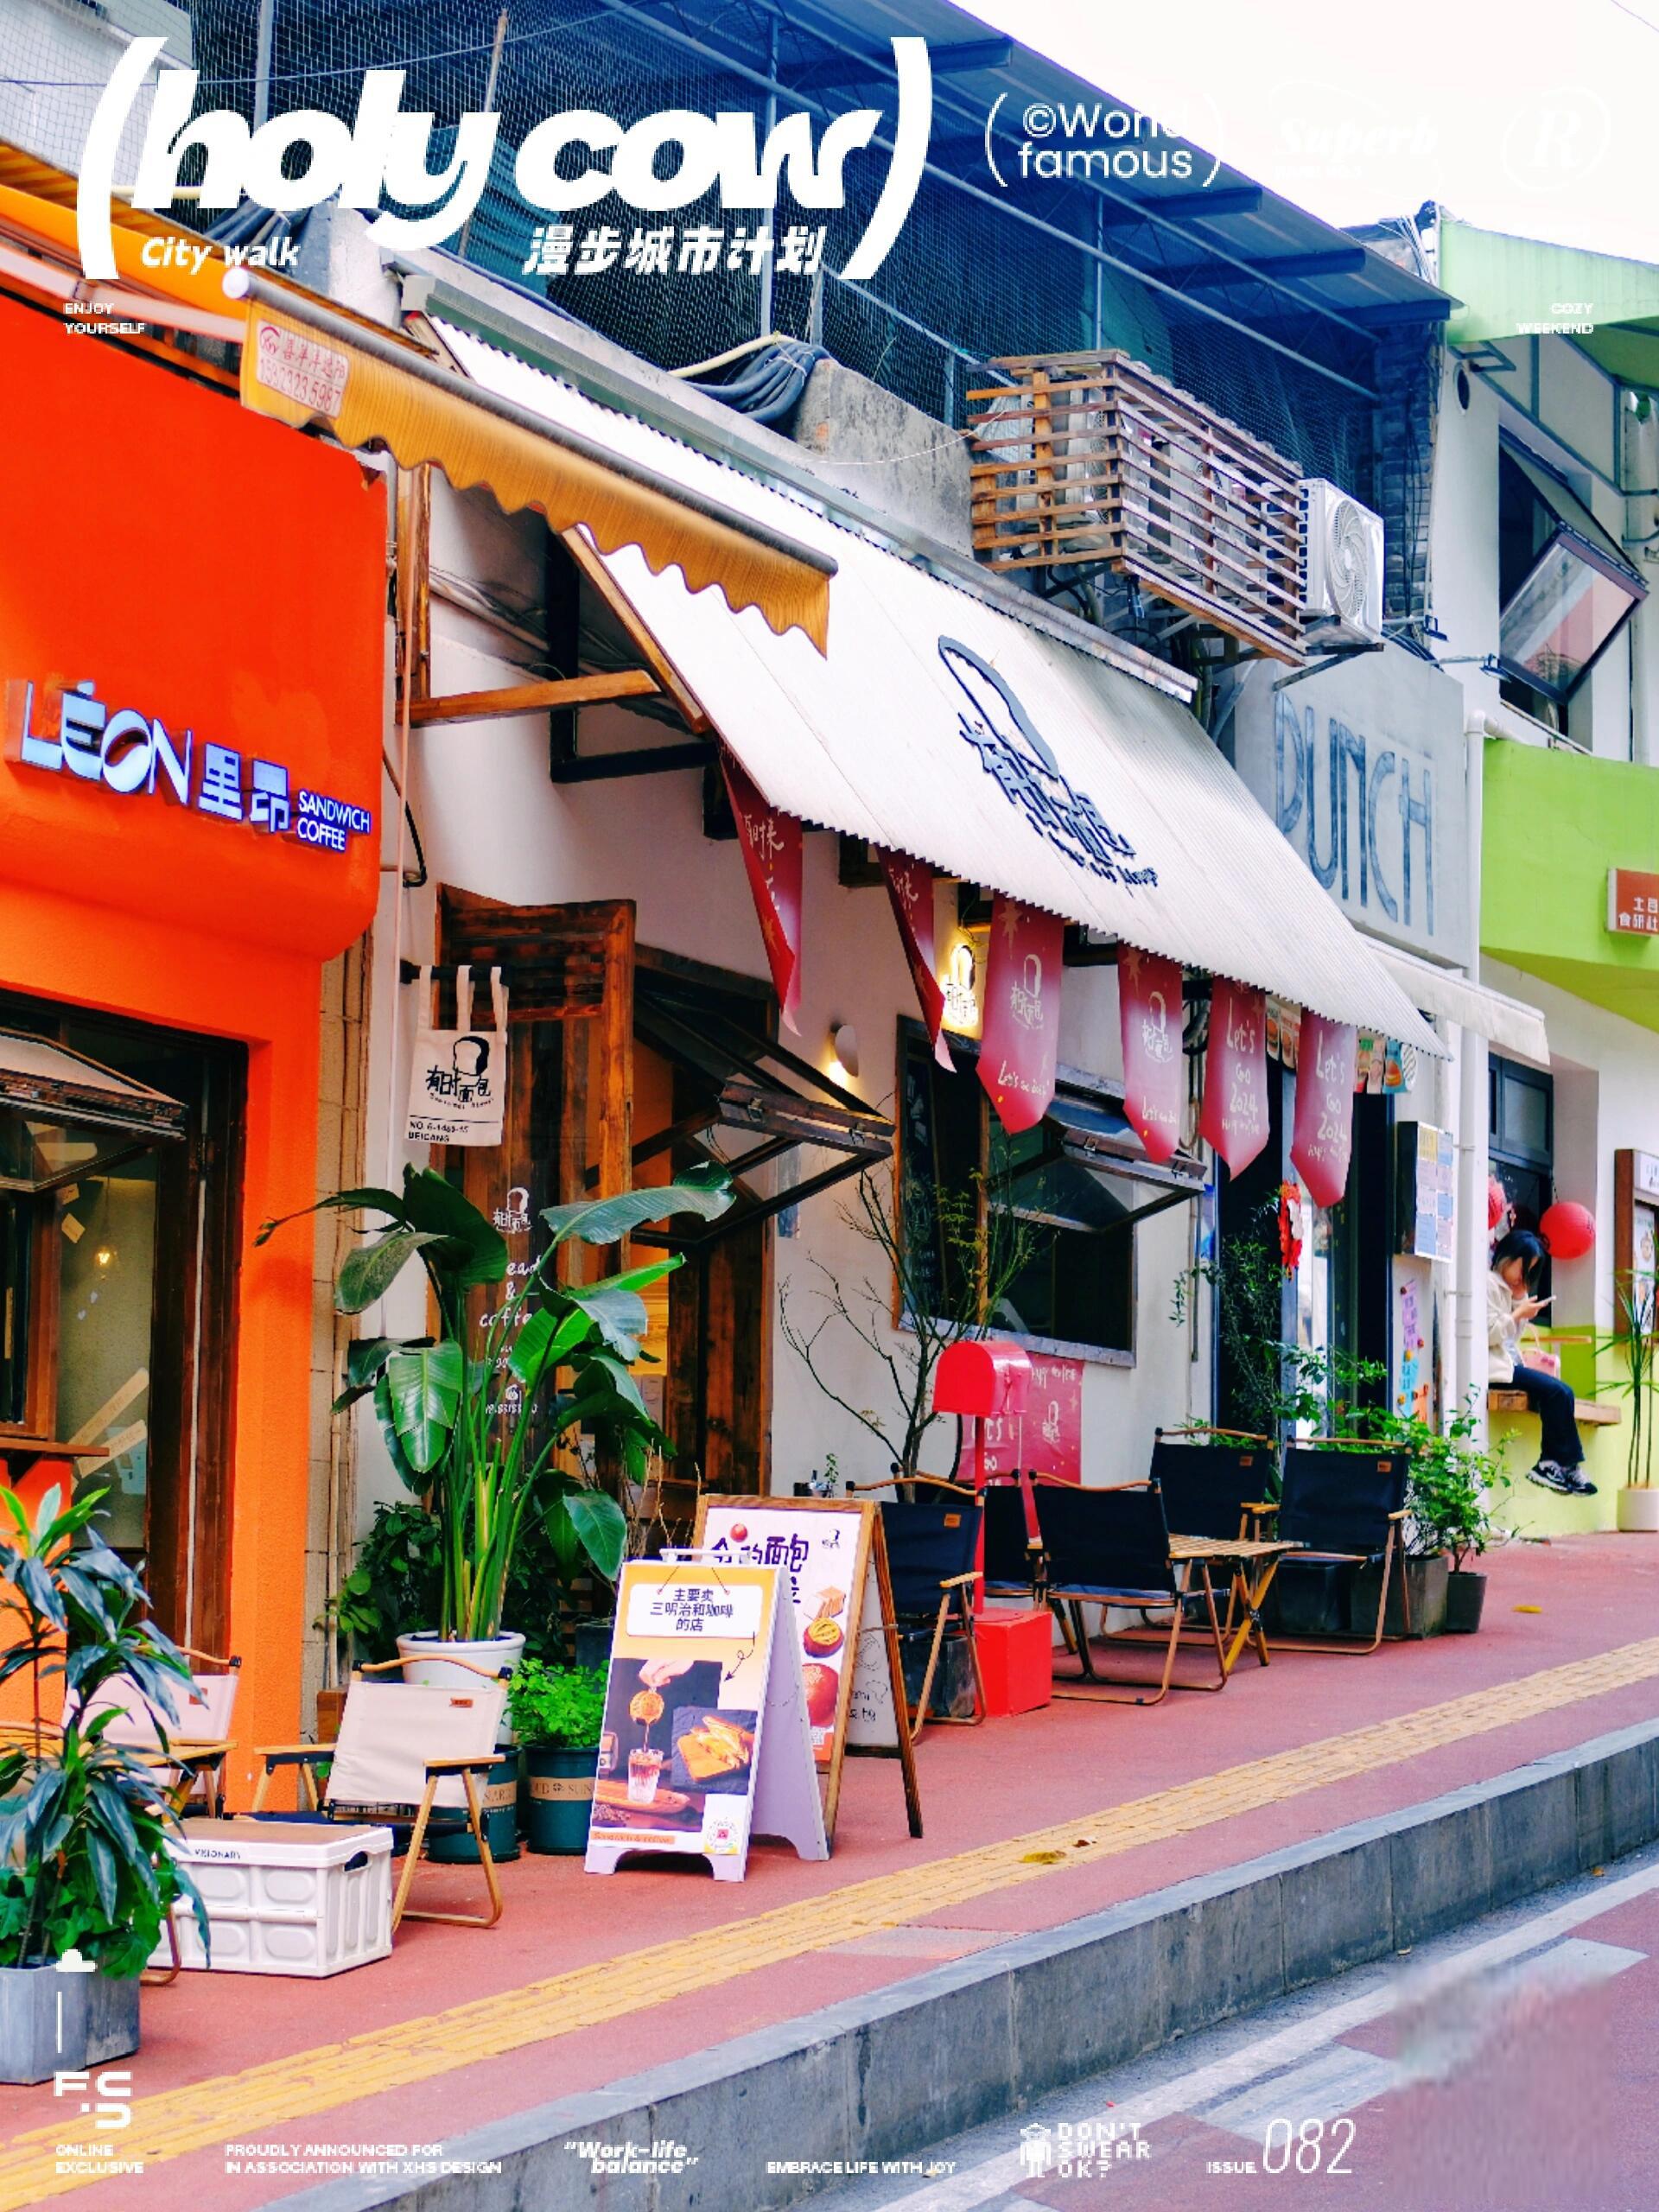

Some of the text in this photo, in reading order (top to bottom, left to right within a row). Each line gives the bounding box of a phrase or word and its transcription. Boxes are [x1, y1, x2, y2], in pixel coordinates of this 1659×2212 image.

[296, 787, 372, 836] SANDWICH
[296, 817, 346, 854] COFFEE
[1226, 996, 1255, 1054] Let's
[1315, 1029, 1345, 1085] Let's
[425, 1065, 492, 1103] 有时面包
[650, 1602, 734, 1618] 三明治和咖啡
[673, 1588, 714, 1602] 主要卖
[676, 1618, 704, 1631] 的店
